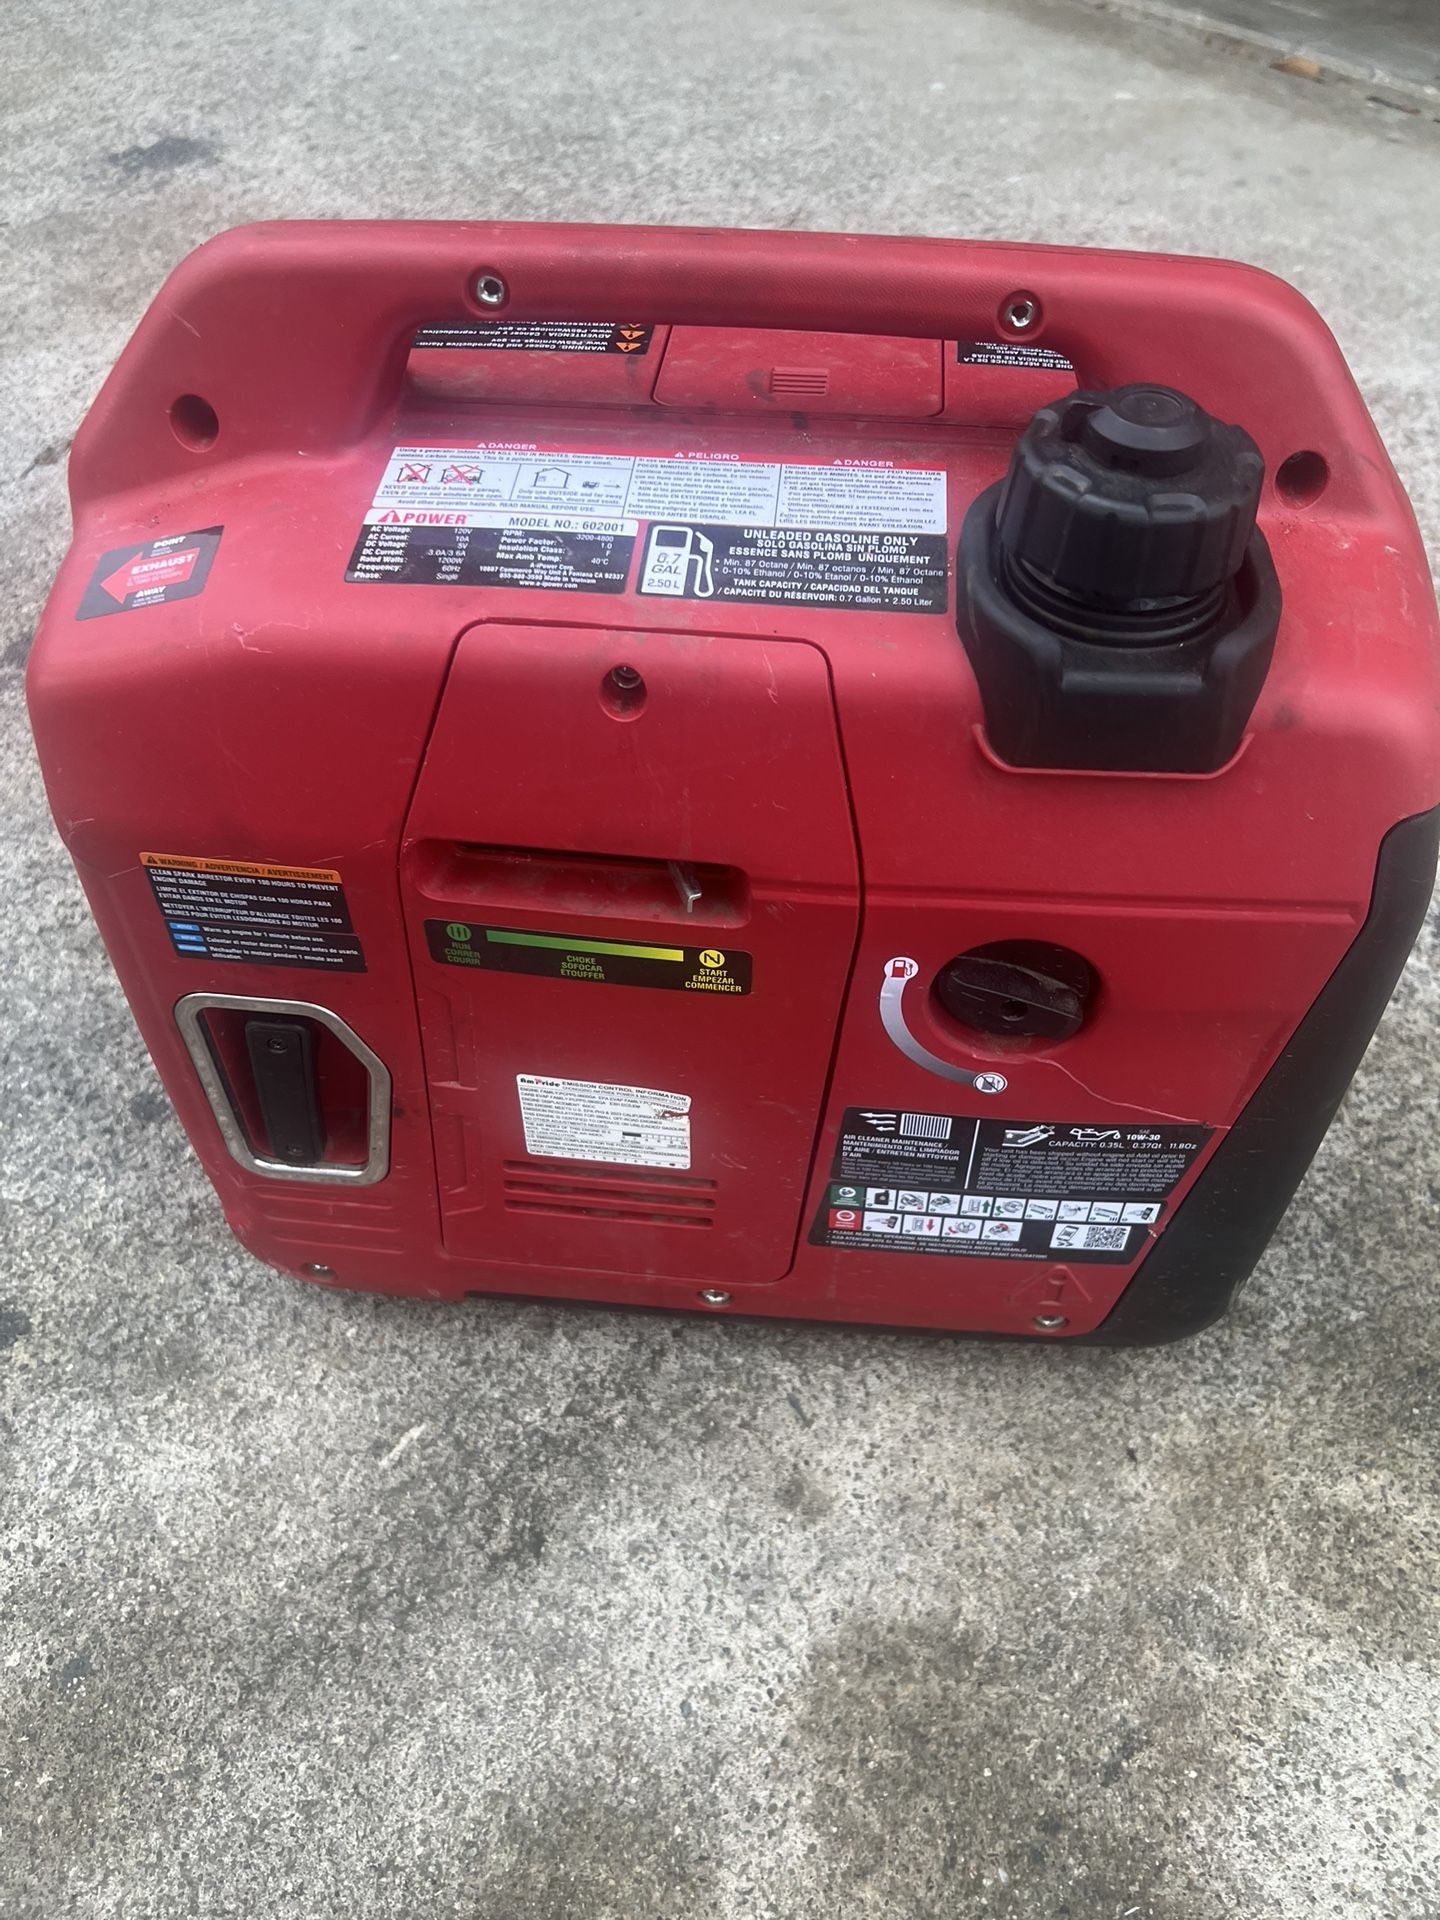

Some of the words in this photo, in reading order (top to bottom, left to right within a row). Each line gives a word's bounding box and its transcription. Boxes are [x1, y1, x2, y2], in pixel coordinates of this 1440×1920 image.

[488, 442, 537, 450] DANGER
[688, 452, 739, 460] PELIGRO
[844, 459, 893, 467] DANGER
[509, 518, 550, 528] MODEL
[554, 520, 578, 529] NO.:
[582, 522, 624, 532] 602001
[153, 536, 186, 548] POINT
[528, 538, 556, 546] Factor:
[576, 534, 614, 542] 3200-4800
[744, 529, 811, 541] UNLEADED
[816, 533, 879, 544] GASOLINE
[884, 536, 918, 546] ONLY
[499, 544, 538, 552] Insulation
[757, 539, 785, 548] SOLO
[789, 541, 842, 551] GASOLINA
[846, 544, 864, 552] SIN
[868, 545, 906, 554] PLOMO
[537, 554, 562, 562] Temp:
[657, 553, 682, 564] 0.7
[729, 547, 778, 557] ESSENCE
[781, 550, 809, 559] SANS
[813, 551, 851, 560] PLOMB
[858, 553, 931, 564] UNIQUEMENT
[131, 554, 196, 575] EXHAUST
[357, 564, 402, 572] Frequency:
[652, 564, 681, 575] GAL
[759, 561, 788, 569] Octane
[832, 565, 866, 573] octanos
[534, 568, 547, 576] Way
[722, 567, 750, 576] 0-10%
[754, 568, 785, 577] Ethanol
[825, 573, 851, 581] Etanol
[860, 575, 888, 583] 0-10%
[648, 579, 671, 588] 2.50
[674, 580, 680, 589] L
[733, 578, 756, 587] TANK
[759, 580, 802, 589] CAPACITY
[810, 583, 861, 592] CAPACIDAD
[883, 587, 919, 595] TANQUE
[136, 586, 166, 597] AWAY
[724, 587, 767, 597] CAPACITÉ
[784, 590, 837, 602] RÉSERVOIR:
[839, 594, 853, 602] 0.7
[855, 595, 881, 604] Gallon
[914, 598, 933, 606] Liter
[159, 858, 197, 868] WARNING
[206, 863, 260, 874] ADVERTENCIA
[267, 869, 333, 880] AVERTISSEMENT
[153, 876, 178, 884] ENGINE
[179, 878, 207, 886] DAMAGE
[173, 870, 196, 878] SPARK
[197, 873, 233, 882] ARRESTOR
[188, 889, 219, 897] EXTINTOR
[230, 893, 257, 901] CHISPAS
[162, 902, 195, 911] NETTOYER
[291, 914, 316, 922] TOUTES
[452, 942, 471, 950] RUN
[445, 948, 480, 958] CORRER
[447, 955, 481, 965] COURIR
[567, 955, 596, 965] CHOKE
[562, 962, 603, 972] SOFOCAR
[700, 968, 728, 976] START
[561, 969, 605, 980] ETOUFFER
[693, 975, 734, 984] EMPEZAR
[685, 981, 742, 992] COMMENCER
[599, 1085, 634, 1093] CONTROL
[635, 1089, 686, 1101] INFORMATION
[843, 1140, 902, 1150] MANTENIMIENTO
[892, 1139, 942, 1148] MAINTENANCE
[877, 1149, 915, 1157] ENTRETIEN
